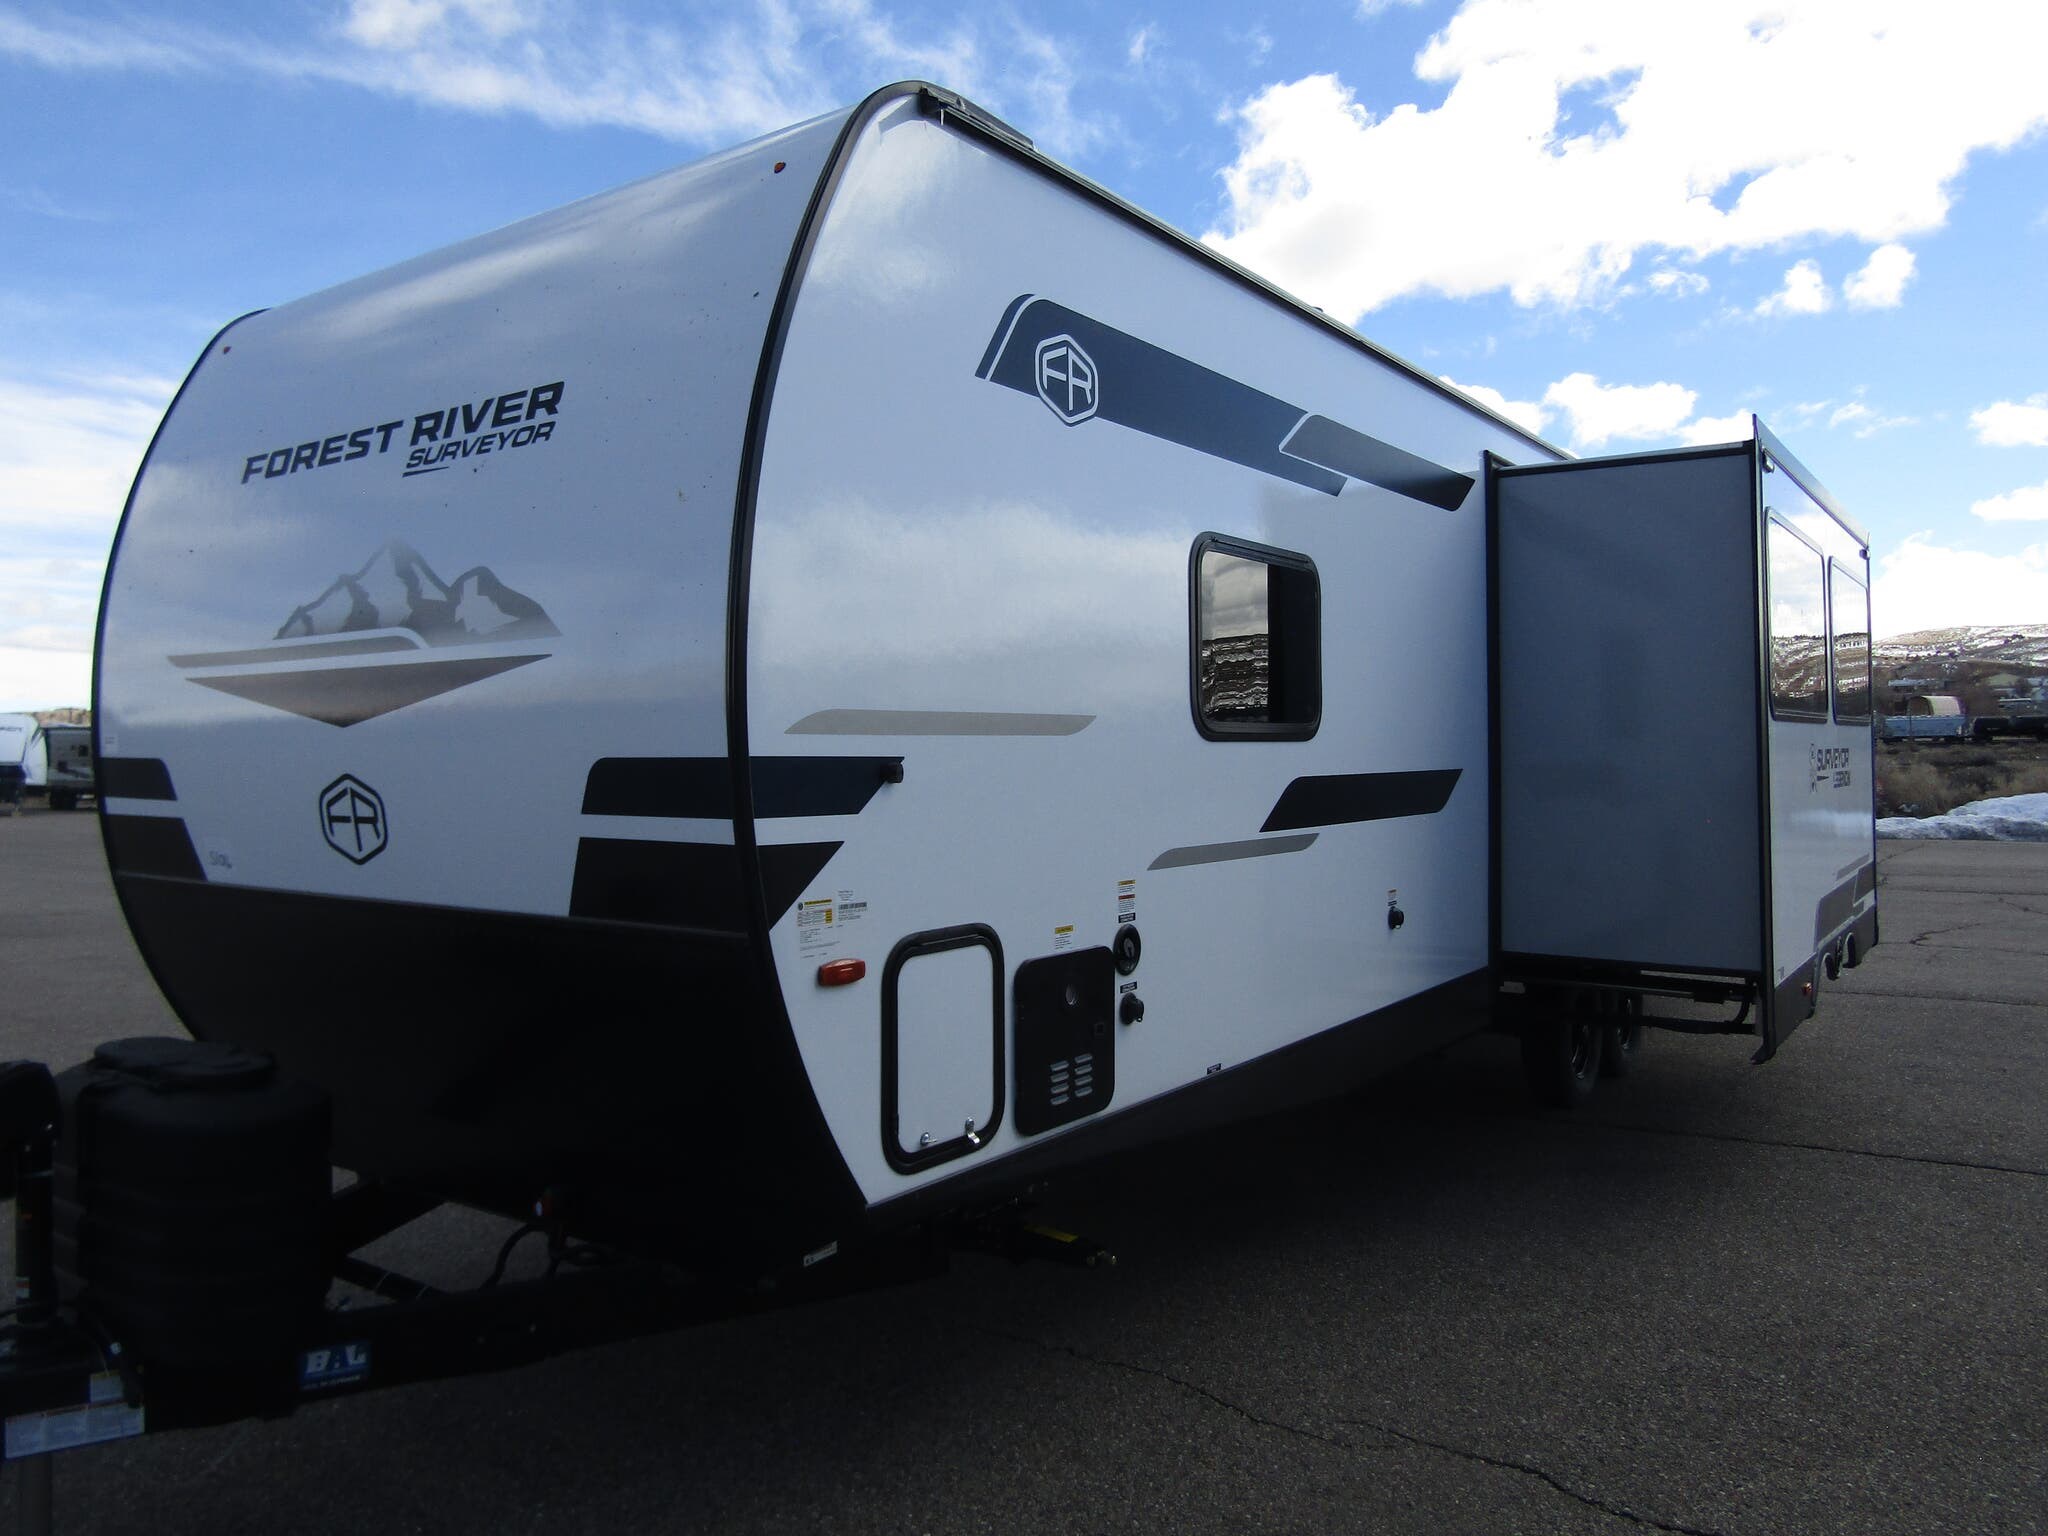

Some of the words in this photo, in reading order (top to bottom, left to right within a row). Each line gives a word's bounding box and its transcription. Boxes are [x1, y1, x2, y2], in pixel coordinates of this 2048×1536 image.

[241, 420, 404, 485] FOREST
[409, 381, 565, 446] RIVER
[406, 421, 557, 469] SURVEYOR
[1816, 748, 1850, 771] SURVEYOR
